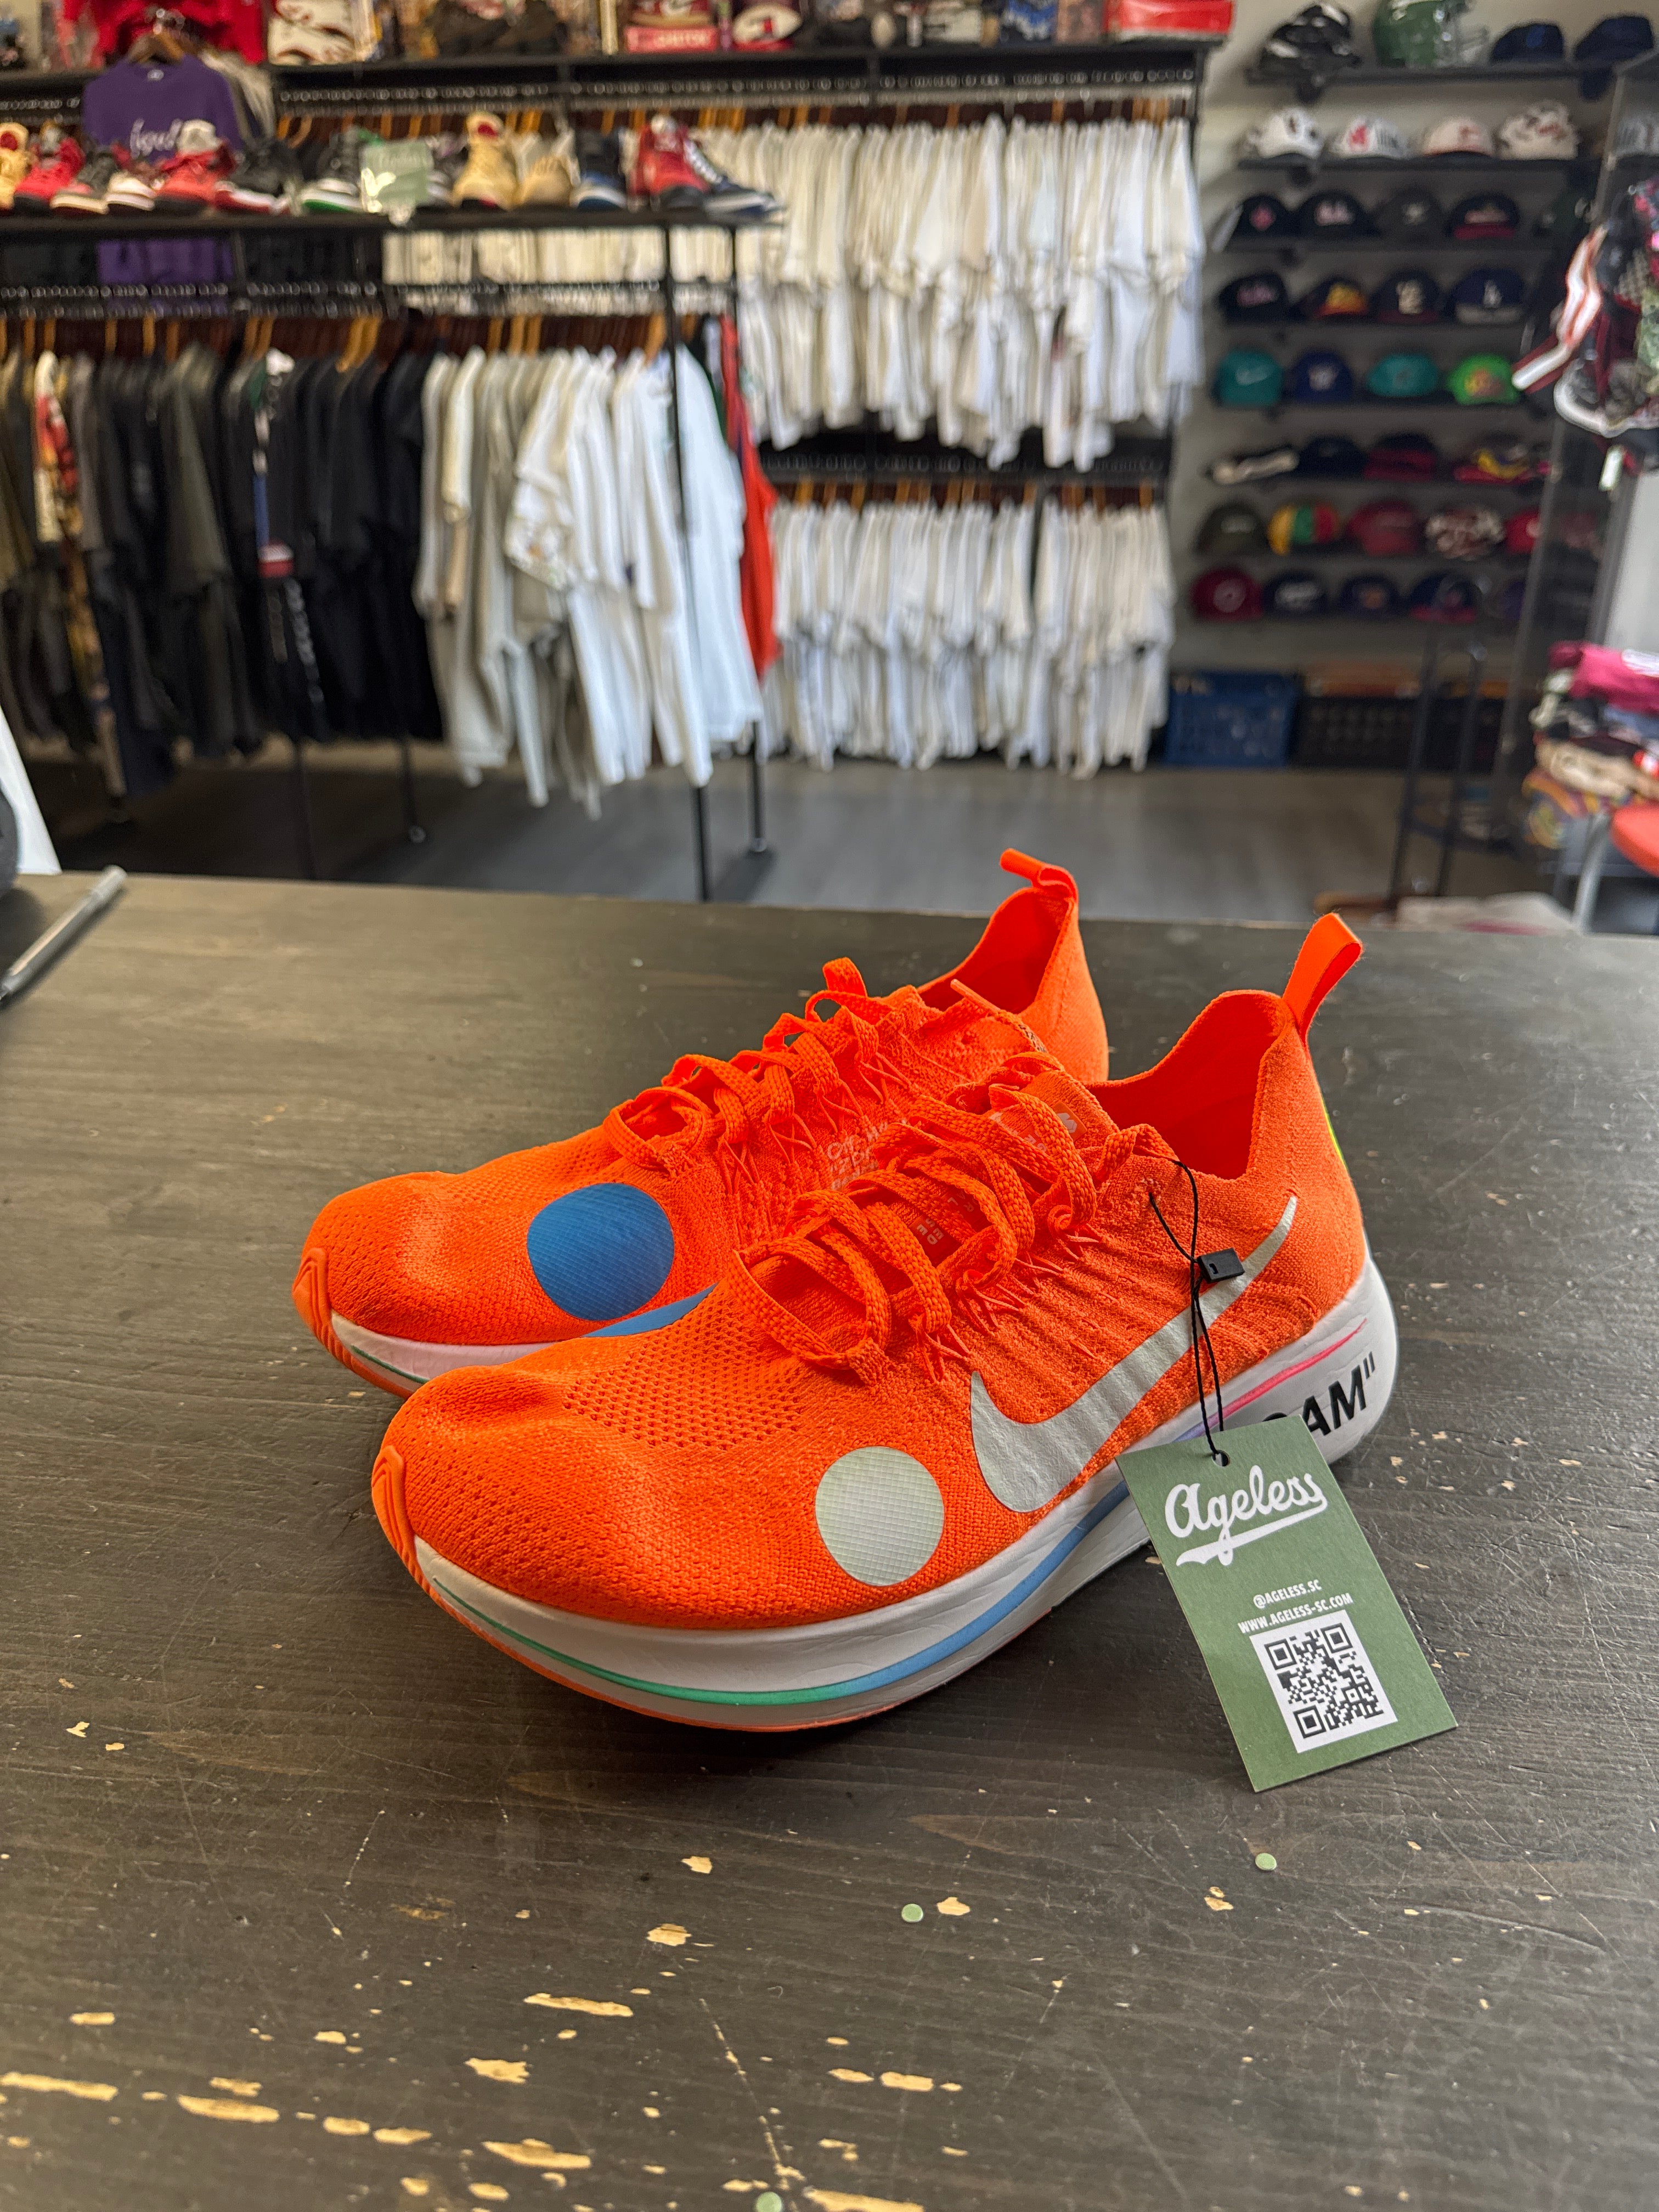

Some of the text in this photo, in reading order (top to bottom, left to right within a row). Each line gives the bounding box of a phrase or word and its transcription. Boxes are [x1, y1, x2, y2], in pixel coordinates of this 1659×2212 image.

[1262, 1351, 1375, 1436] AM"
[1165, 1465, 1328, 1566] Ageless
[1238, 1593, 1353, 1633] WWW.AGELESS-SC.COM
[1253, 1579, 1322, 1609] @AGELESS.SC
